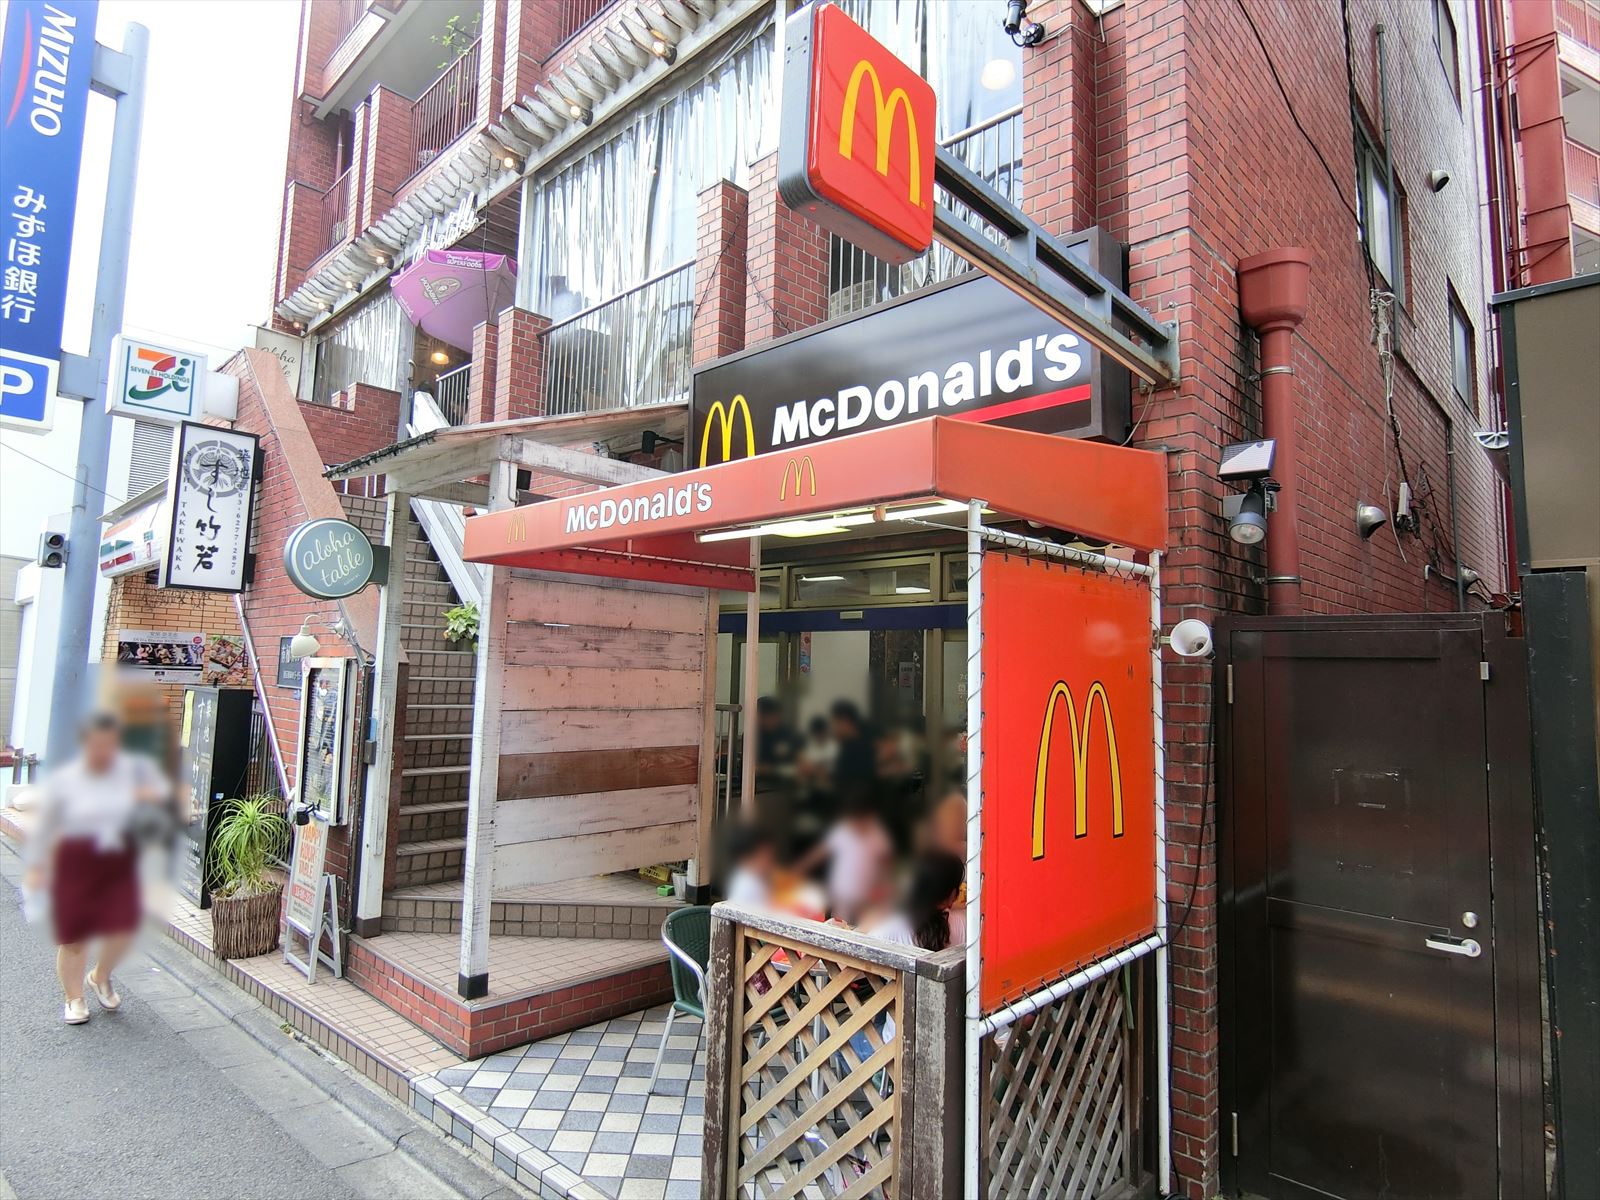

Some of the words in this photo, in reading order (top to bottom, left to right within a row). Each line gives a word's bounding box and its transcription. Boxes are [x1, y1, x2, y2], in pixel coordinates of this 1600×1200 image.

[31, 3, 76, 136] MIZUHO
[1, 185, 47, 324] みずほ銀行
[0, 365, 33, 406] P
[771, 332, 1083, 447] McDonald's
[174, 501, 187, 571] TAKEWAKA
[565, 481, 713, 534] McDonald's
[303, 530, 355, 571] aloha
[321, 549, 365, 587] table
